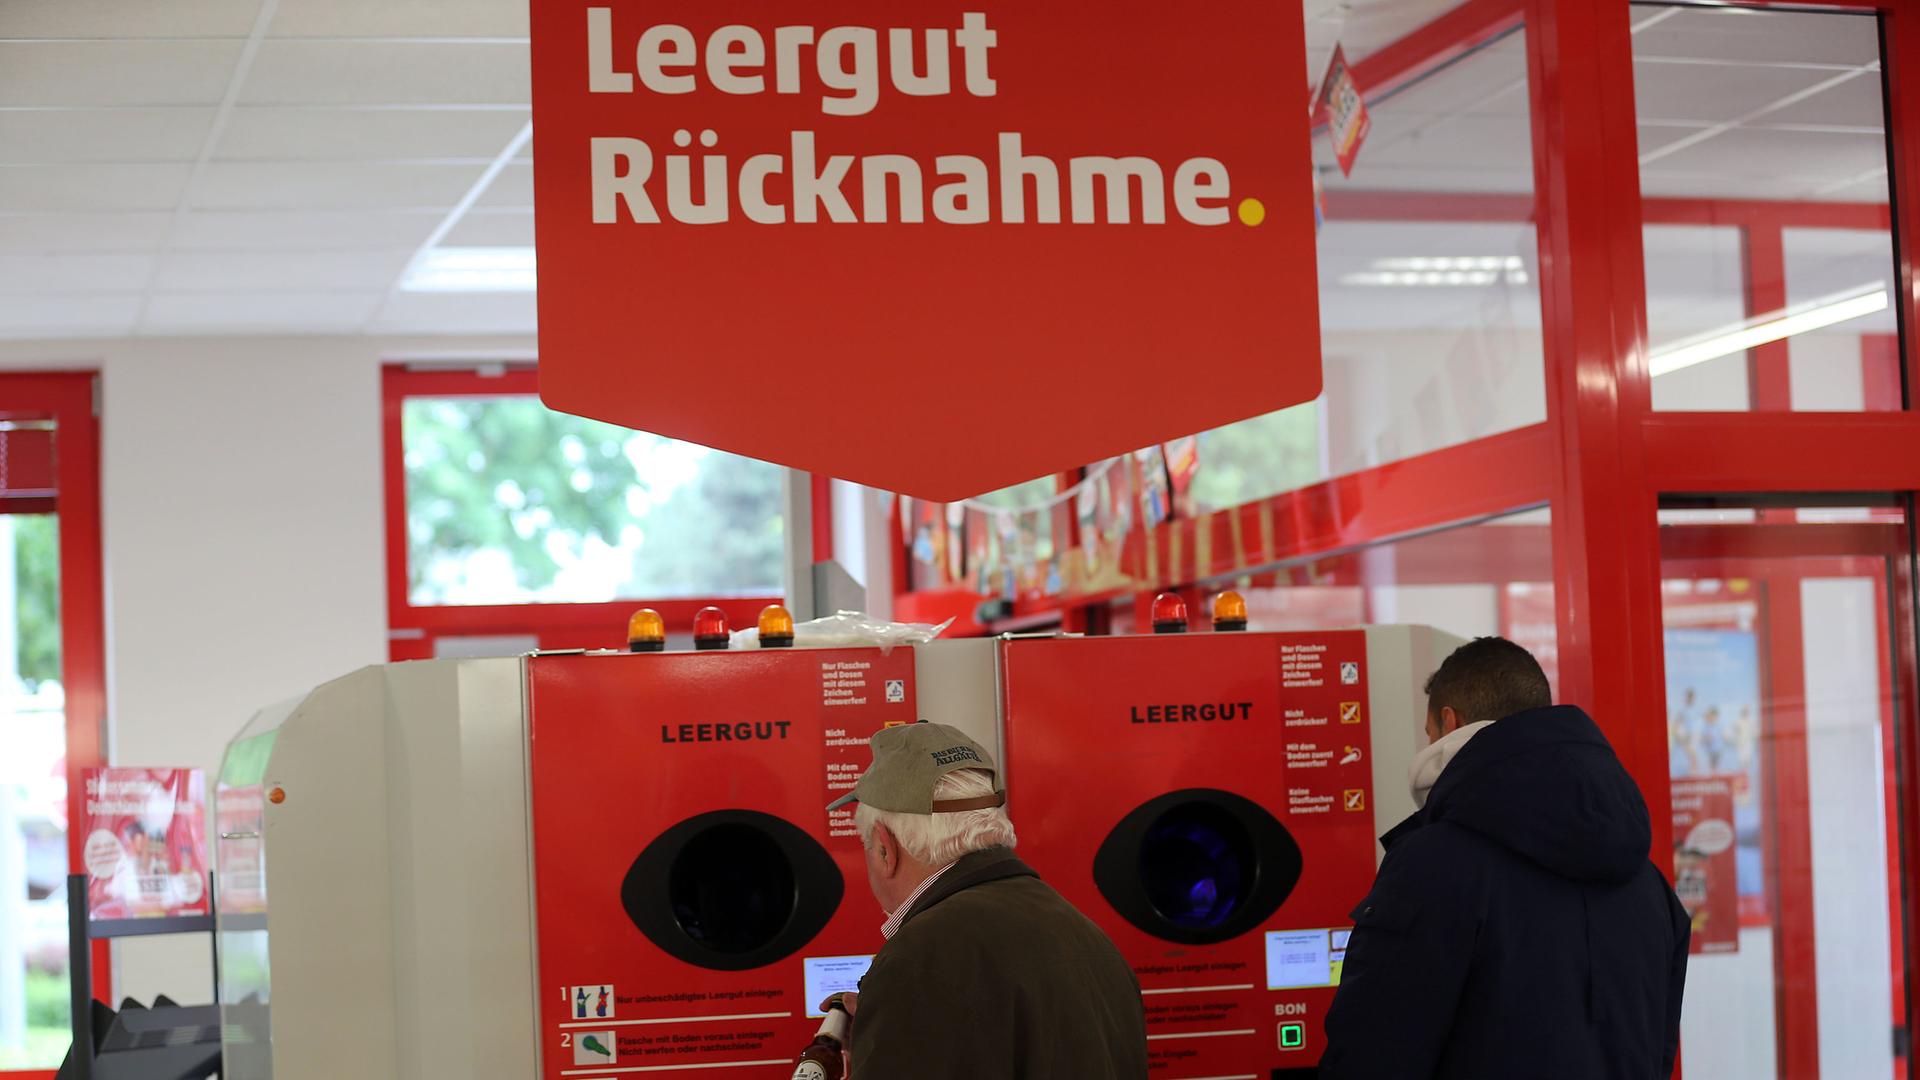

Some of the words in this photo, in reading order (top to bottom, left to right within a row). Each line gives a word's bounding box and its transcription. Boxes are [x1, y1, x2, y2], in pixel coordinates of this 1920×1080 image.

[587, 7, 997, 115] Leergut
[590, 130, 1265, 226] Rücknahme.
[823, 671, 838, 679] und
[823, 680, 836, 688] mit
[824, 689, 853, 697] Zeichen
[1131, 702, 1253, 723] LEERGUT
[662, 721, 791, 743] LEERGUT
[825, 729, 845, 737] Nicht
[560, 987, 567, 1001] 1
[1275, 1003, 1306, 1016] BON
[560, 1033, 571, 1048] 2
